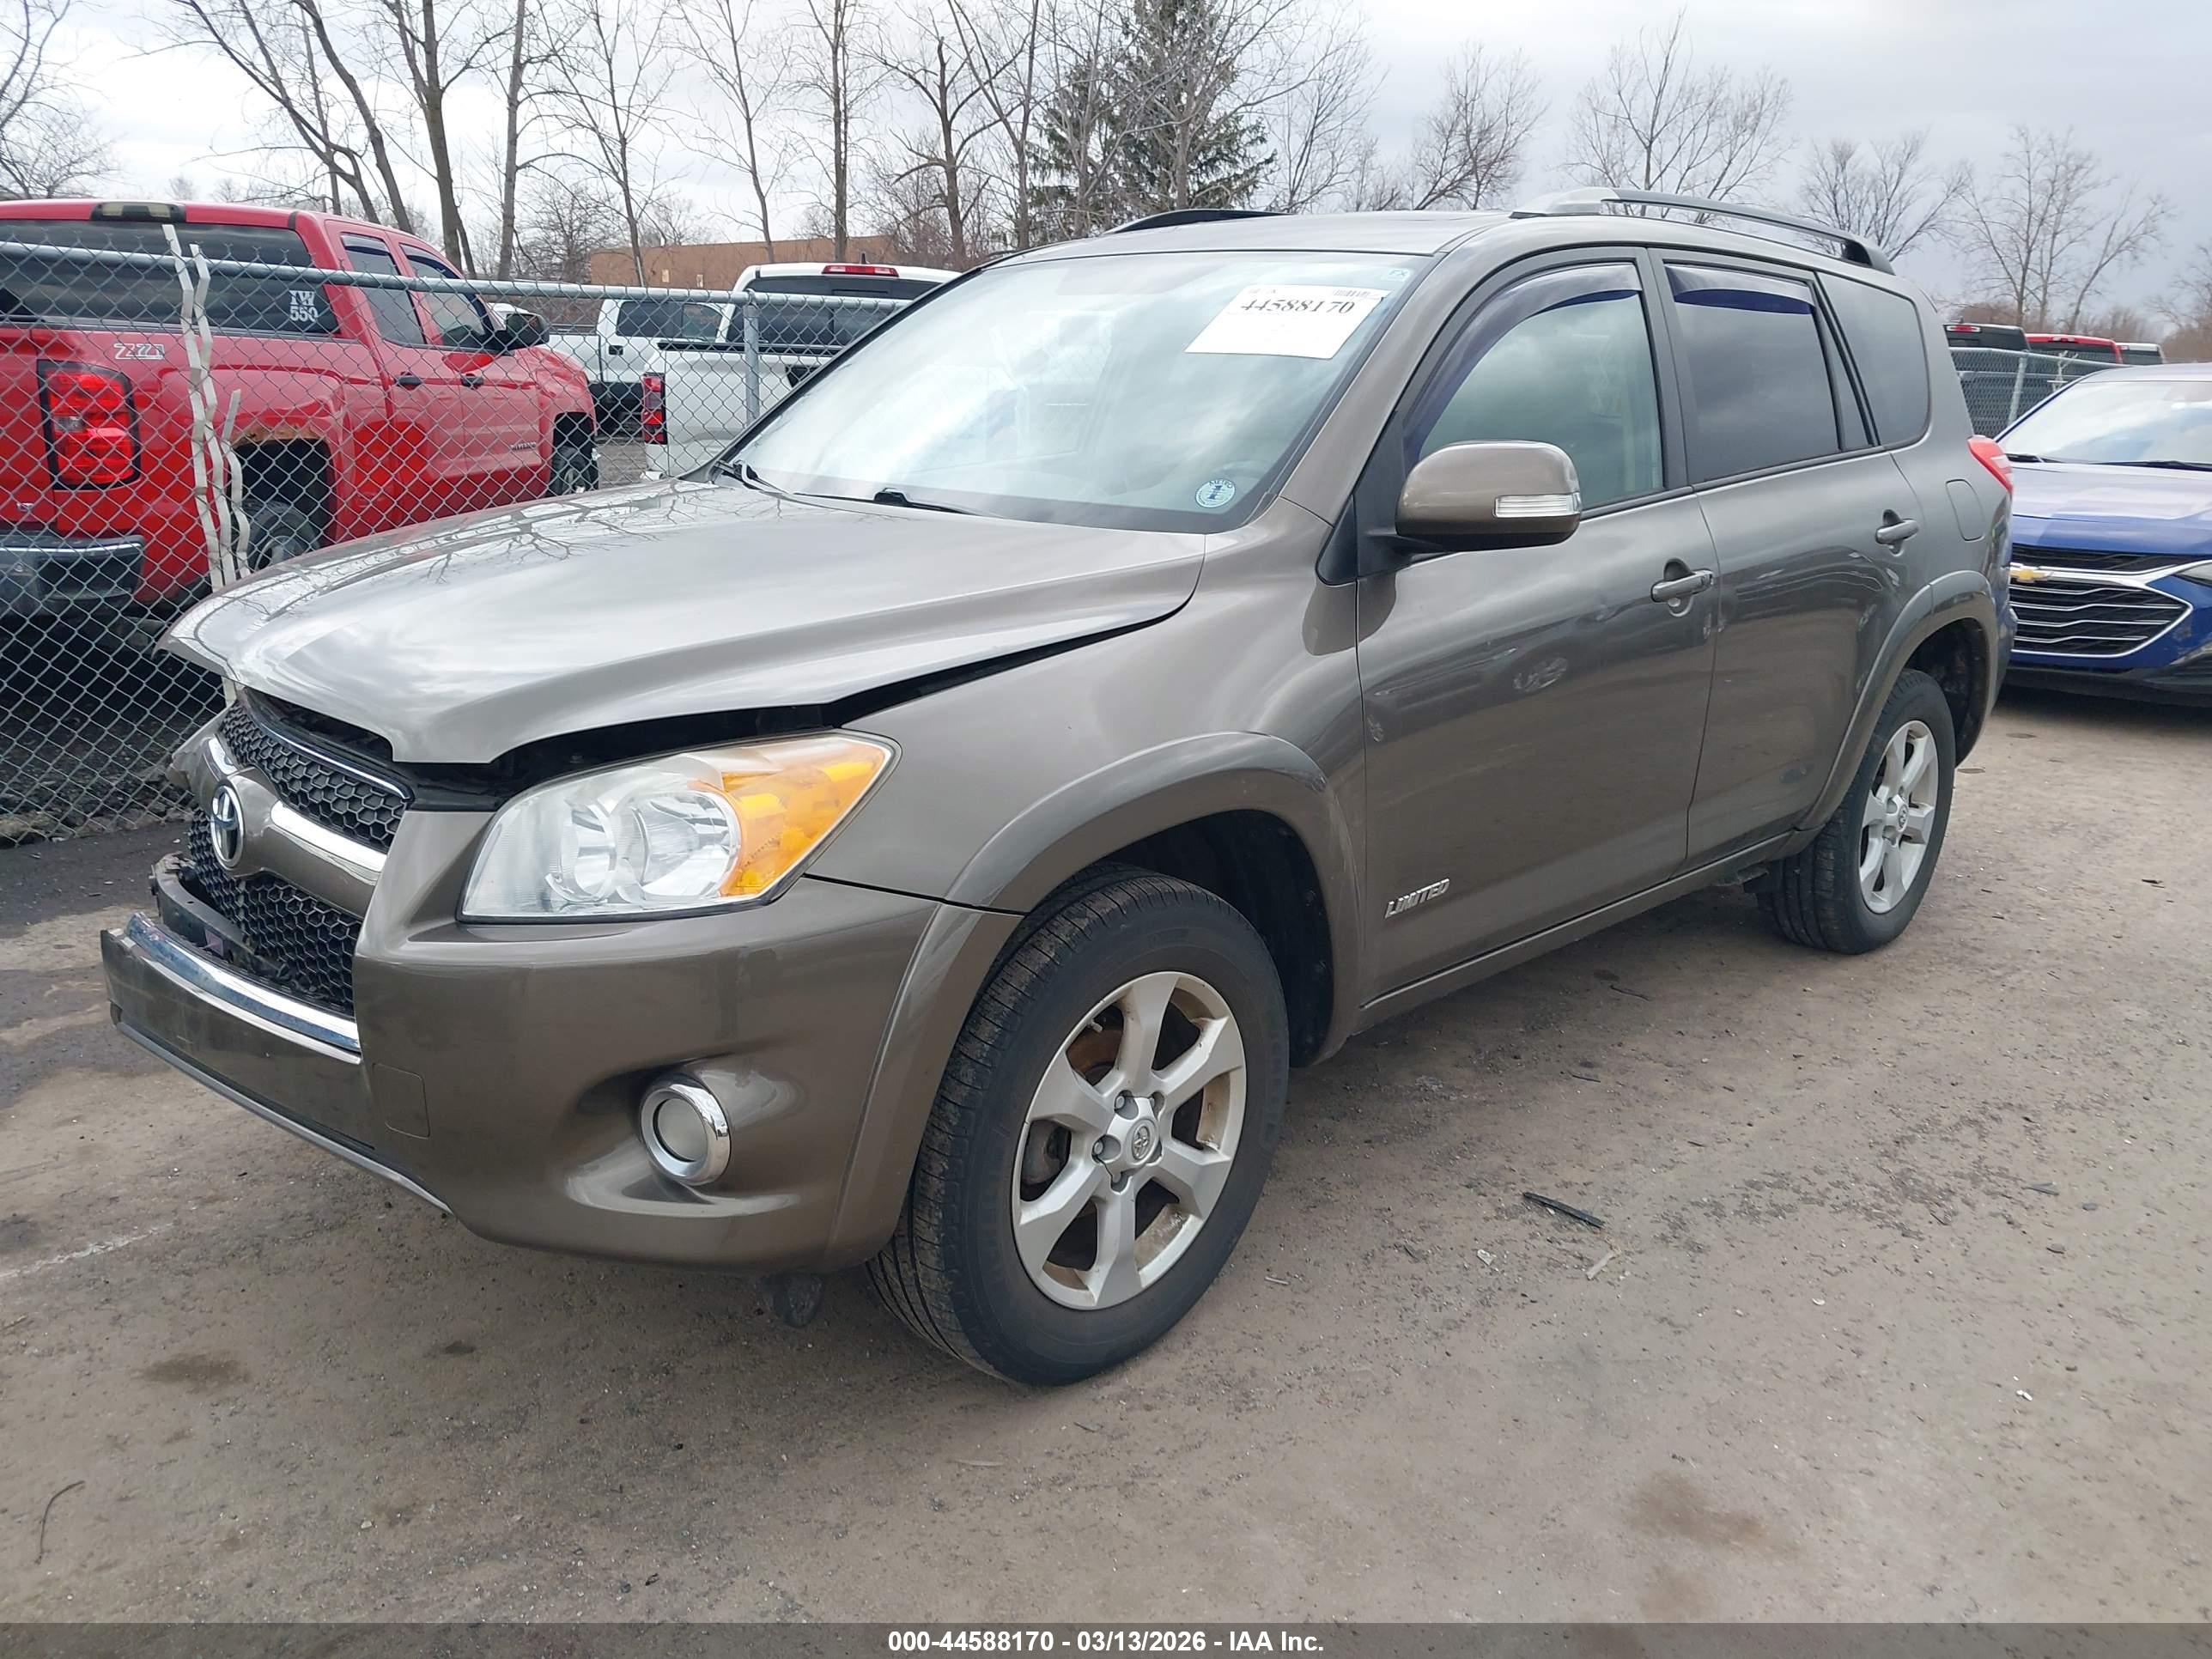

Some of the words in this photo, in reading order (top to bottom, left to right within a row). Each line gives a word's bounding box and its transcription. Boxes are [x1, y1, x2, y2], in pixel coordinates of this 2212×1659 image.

[289, 306, 319, 322] 550
[1241, 299, 1355, 314] 44588170
[1384, 878, 1449, 919] LIMITED
